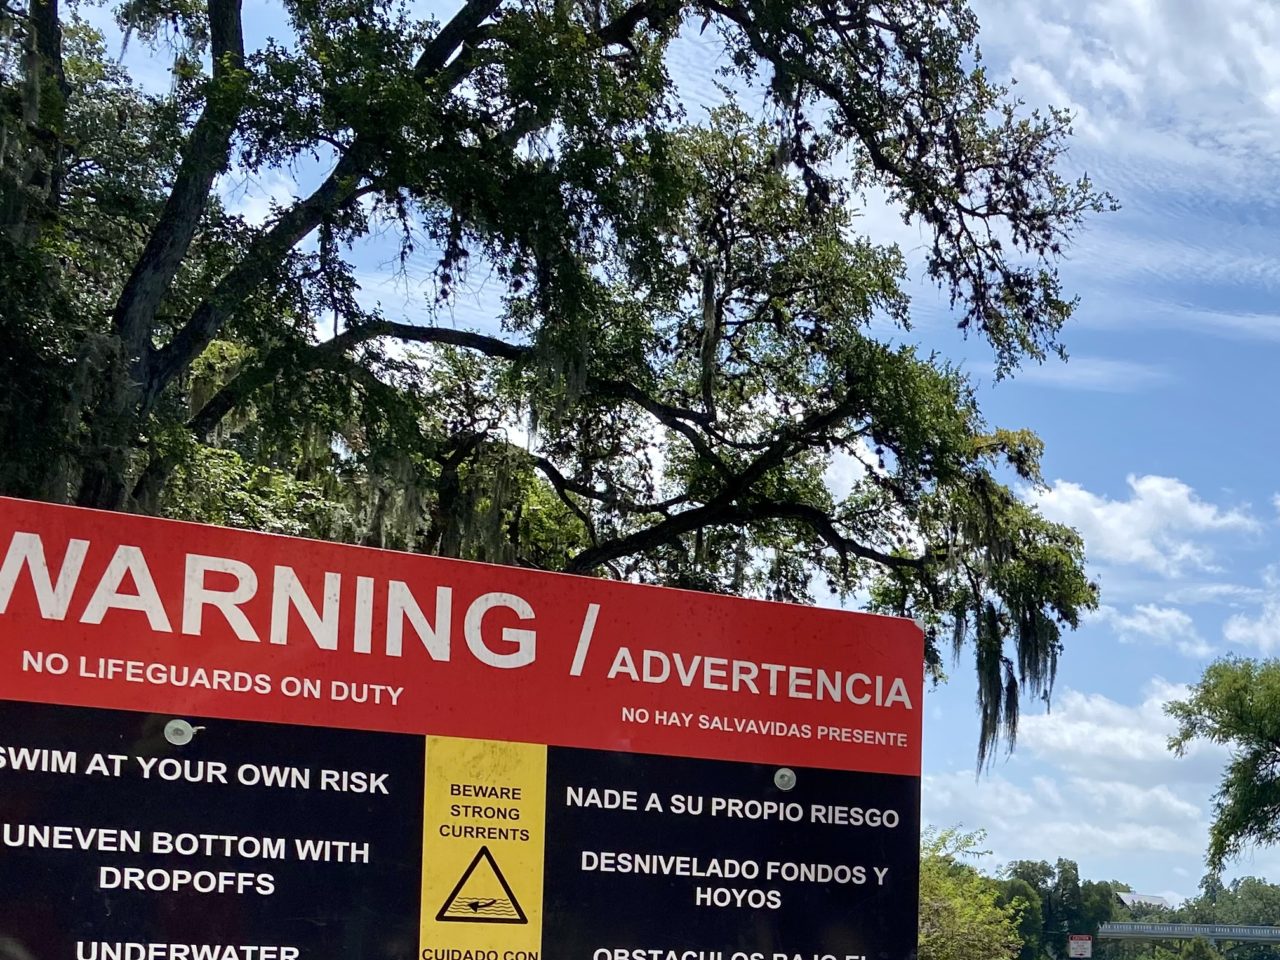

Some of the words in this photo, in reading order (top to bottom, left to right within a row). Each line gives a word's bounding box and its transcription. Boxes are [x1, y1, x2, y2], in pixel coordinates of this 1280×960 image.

[0, 531, 536, 669] WARNING
[570, 604, 600, 676] /
[608, 647, 912, 709] ADVERTENCIA
[23, 651, 68, 674] NO
[80, 656, 271, 694] LIFEGUARDS
[281, 677, 320, 698] ON
[331, 681, 403, 705] DUTY
[623, 707, 649, 723] NO
[656, 711, 693, 727] HAY
[699, 715, 811, 738] SALVAVIDAS
[818, 726, 906, 746] PRESENTE
[86, 754, 127, 776] AT
[136, 757, 227, 783] YOUR
[238, 764, 309, 788] OWN
[321, 770, 388, 794] RISK
[451, 784, 521, 800] BEWARE
[451, 805, 519, 820] STRONG
[567, 787, 637, 810] NADE
[645, 793, 662, 812] A
[671, 795, 702, 814] SU
[712, 798, 803, 821] PROPIO
[811, 805, 898, 827] RIESGO
[4, 824, 140, 852] UNEVEN
[153, 832, 285, 859] BOTTOM
[295, 839, 369, 863] WITH
[440, 825, 529, 841] CURRENTS
[100, 867, 274, 895] DROPOFFS
[582, 851, 758, 879] DESNIVELADO
[767, 862, 865, 884] FONDOS
[874, 867, 888, 884] Y
[697, 887, 781, 908] HOYOS
